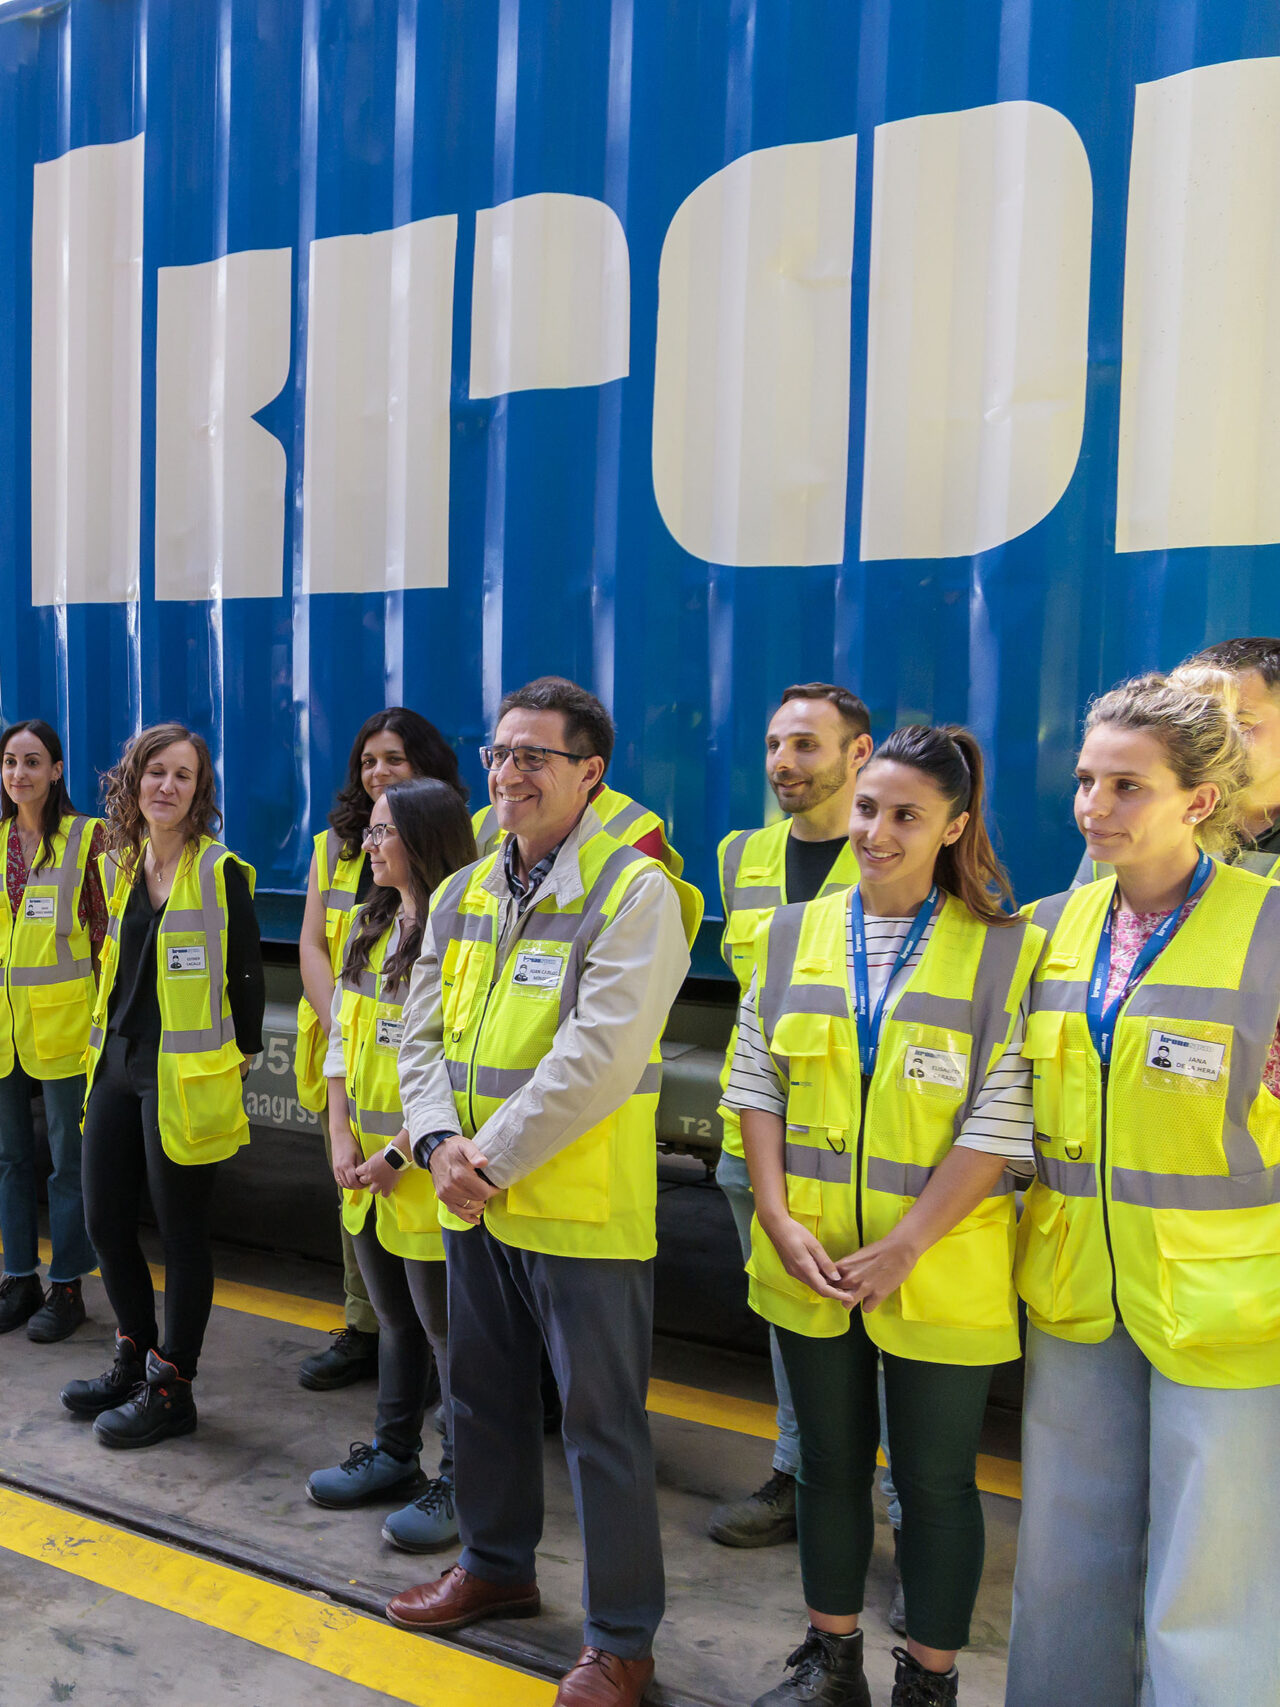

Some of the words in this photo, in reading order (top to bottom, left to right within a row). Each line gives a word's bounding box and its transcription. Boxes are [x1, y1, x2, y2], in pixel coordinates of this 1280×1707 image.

[1188, 1057, 1207, 1065] JANA
[1197, 1067, 1216, 1075] HERA
[678, 1115, 712, 1138] T2
